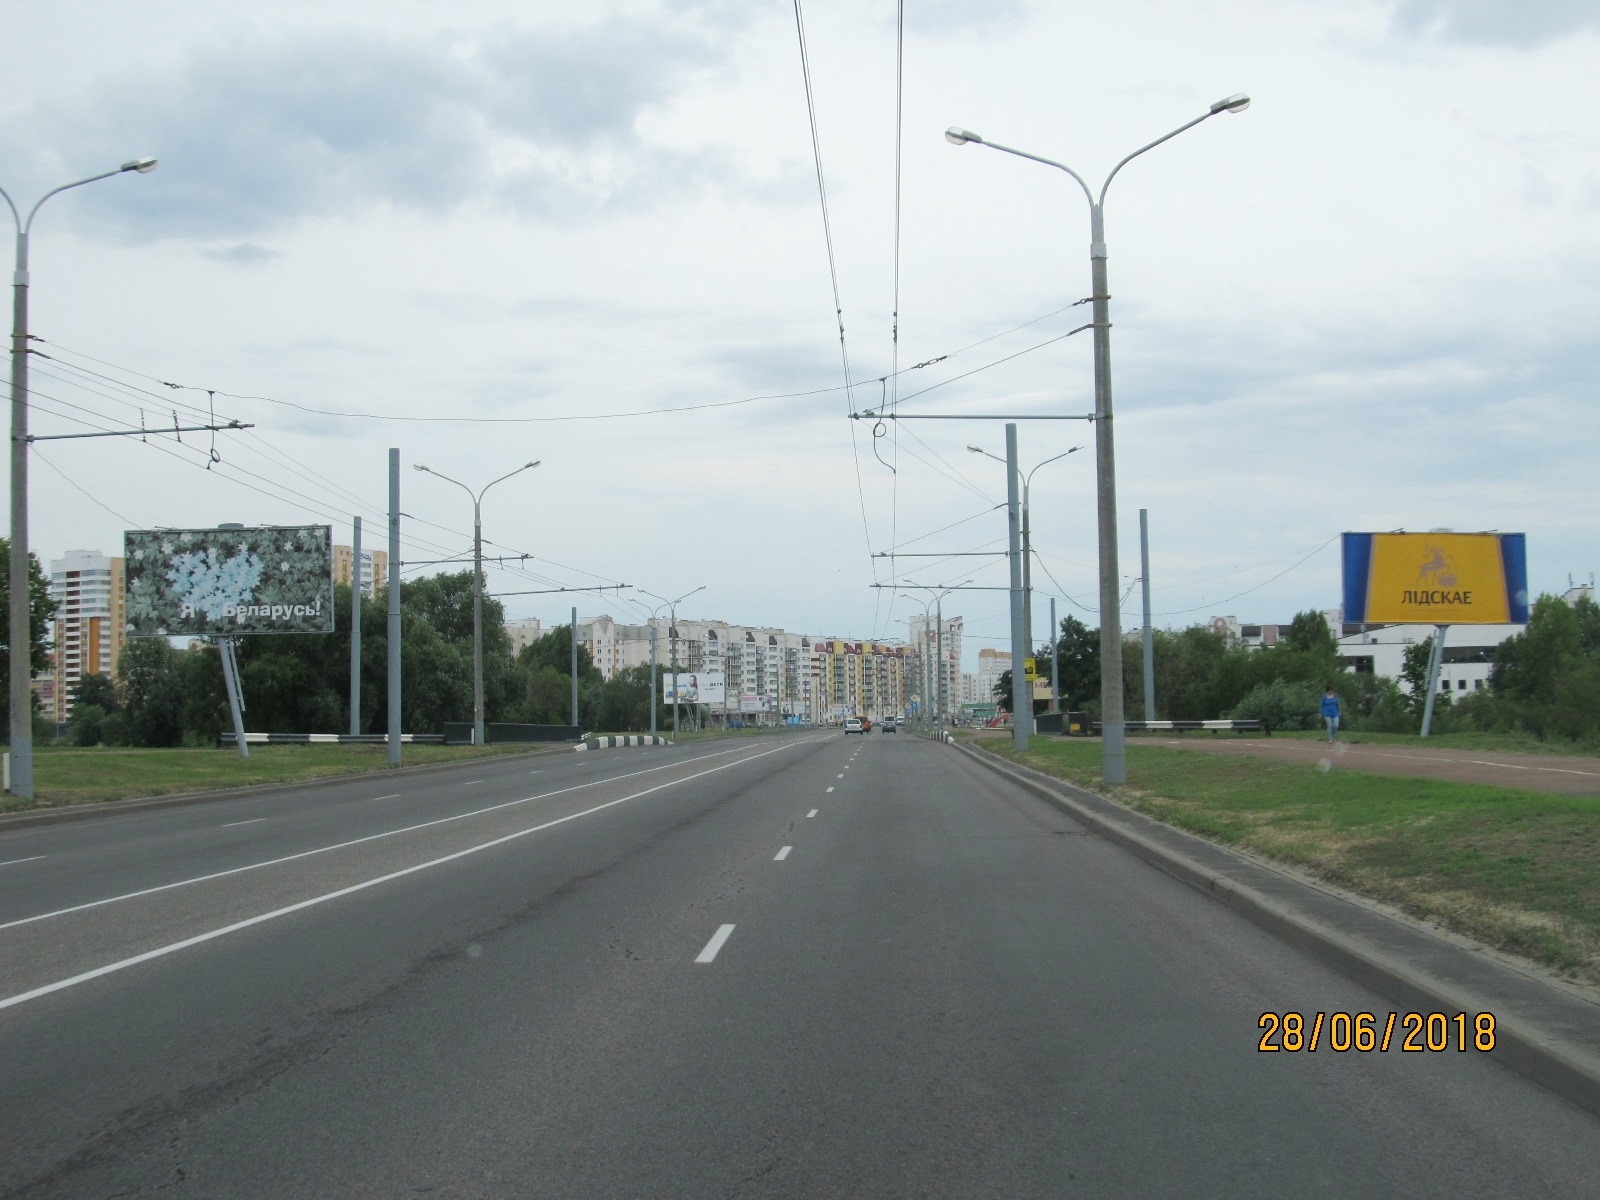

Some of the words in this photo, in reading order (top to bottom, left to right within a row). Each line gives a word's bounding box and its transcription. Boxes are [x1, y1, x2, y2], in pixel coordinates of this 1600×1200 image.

[1401, 590, 1473, 606] ЛІДСКАЕ
[180, 602, 195, 618] Я
[222, 600, 320, 621] Беларусь!
